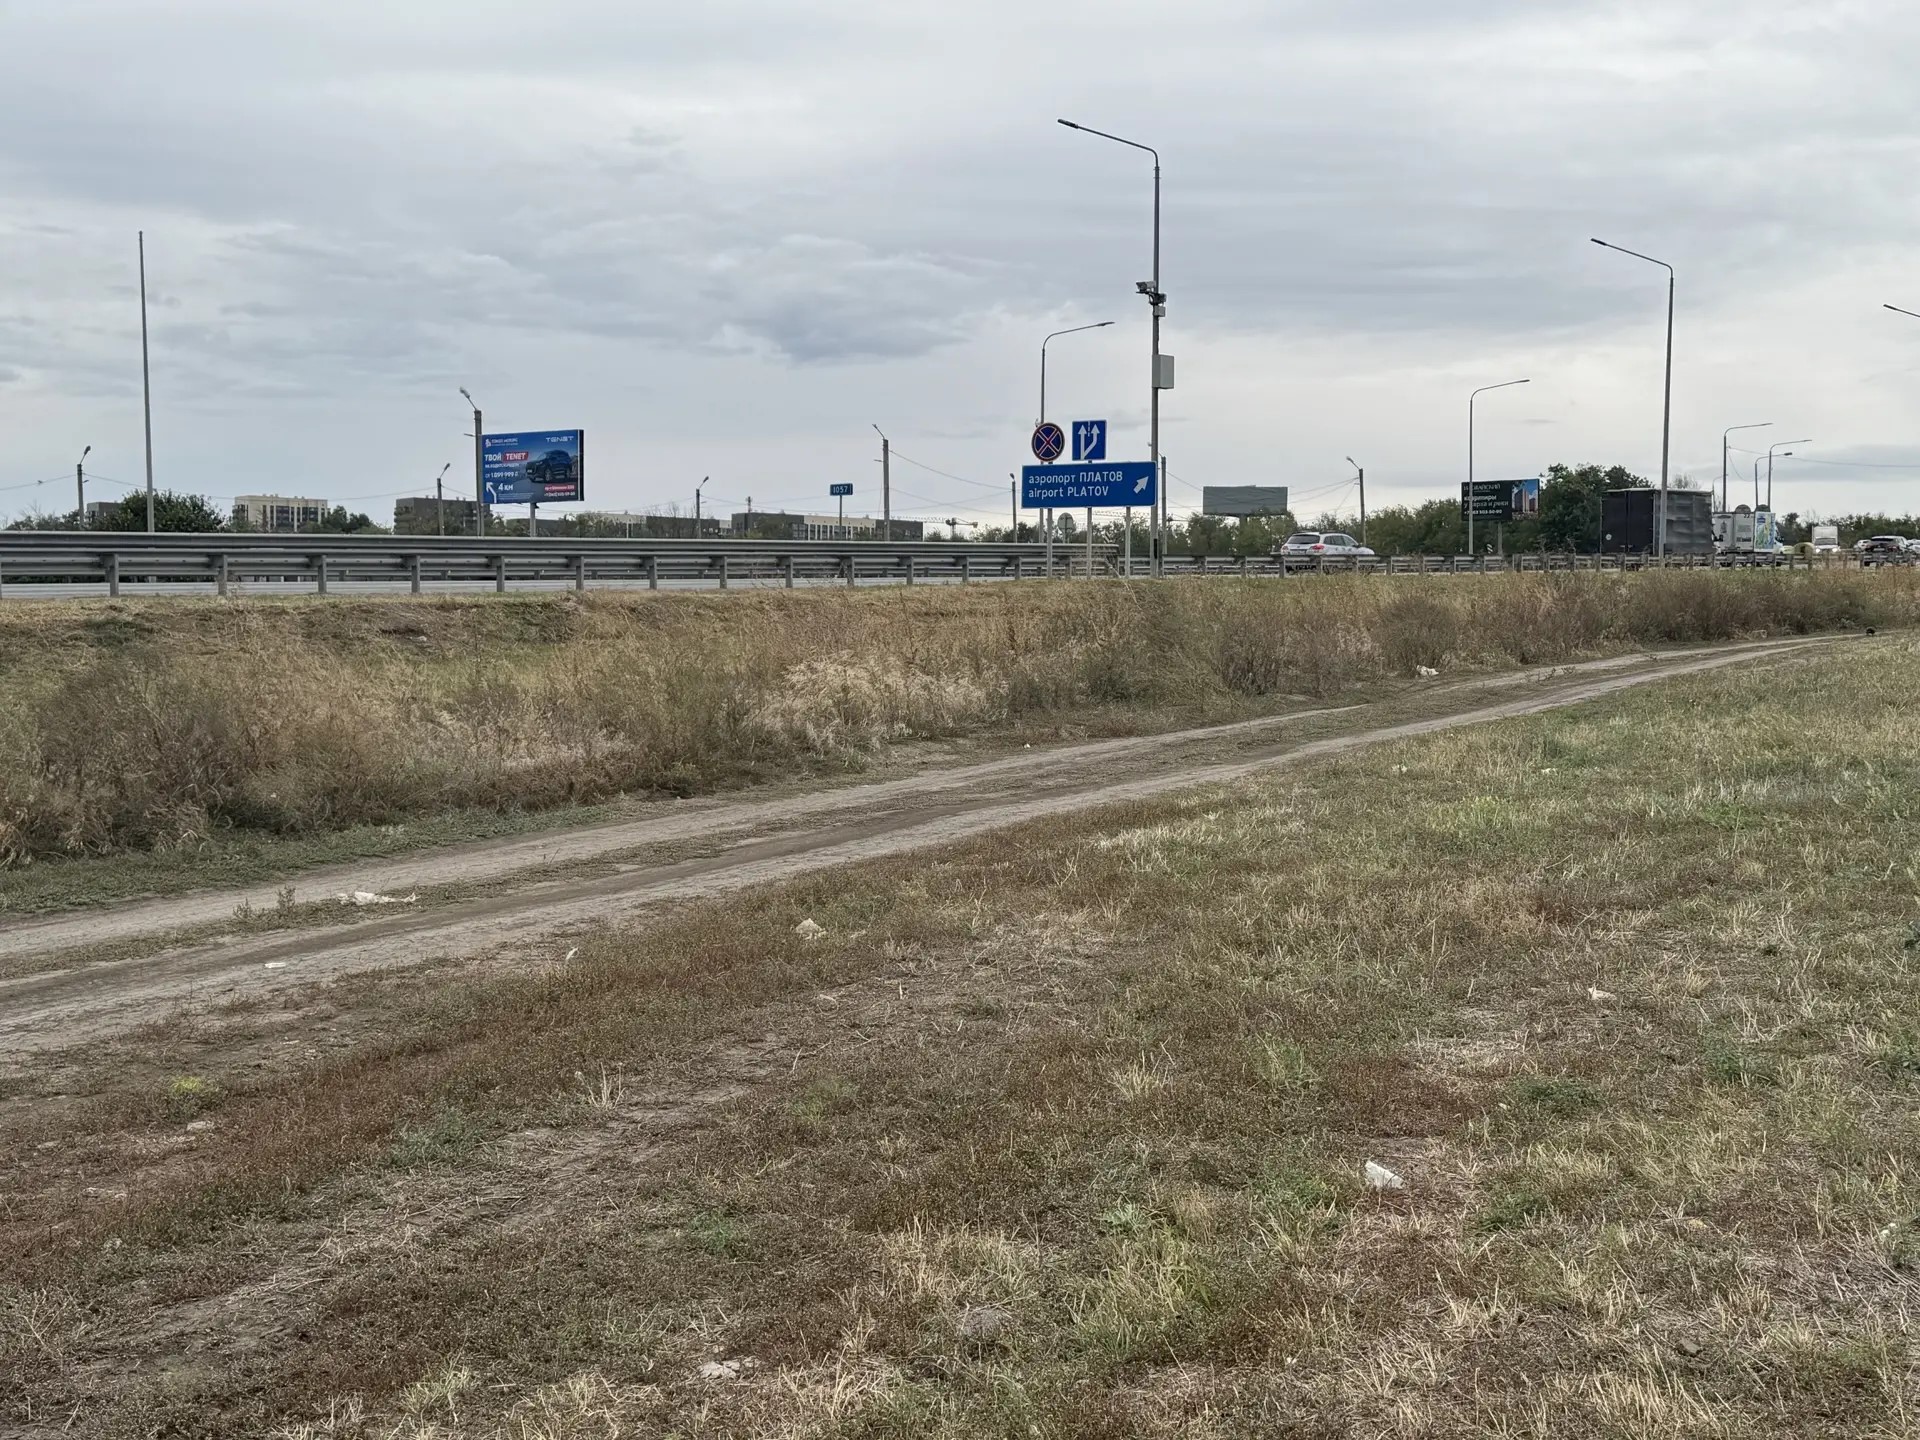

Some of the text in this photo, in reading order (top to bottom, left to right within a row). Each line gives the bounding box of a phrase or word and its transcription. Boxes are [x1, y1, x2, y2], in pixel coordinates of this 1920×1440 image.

[484, 452, 502, 461] ТВОЙ
[506, 452, 526, 460] TENET
[1028, 470, 1123, 486] аэропорт ПЛАТОВ
[498, 482, 502, 490] 4
[1028, 486, 1109, 500] airport PLATOV
